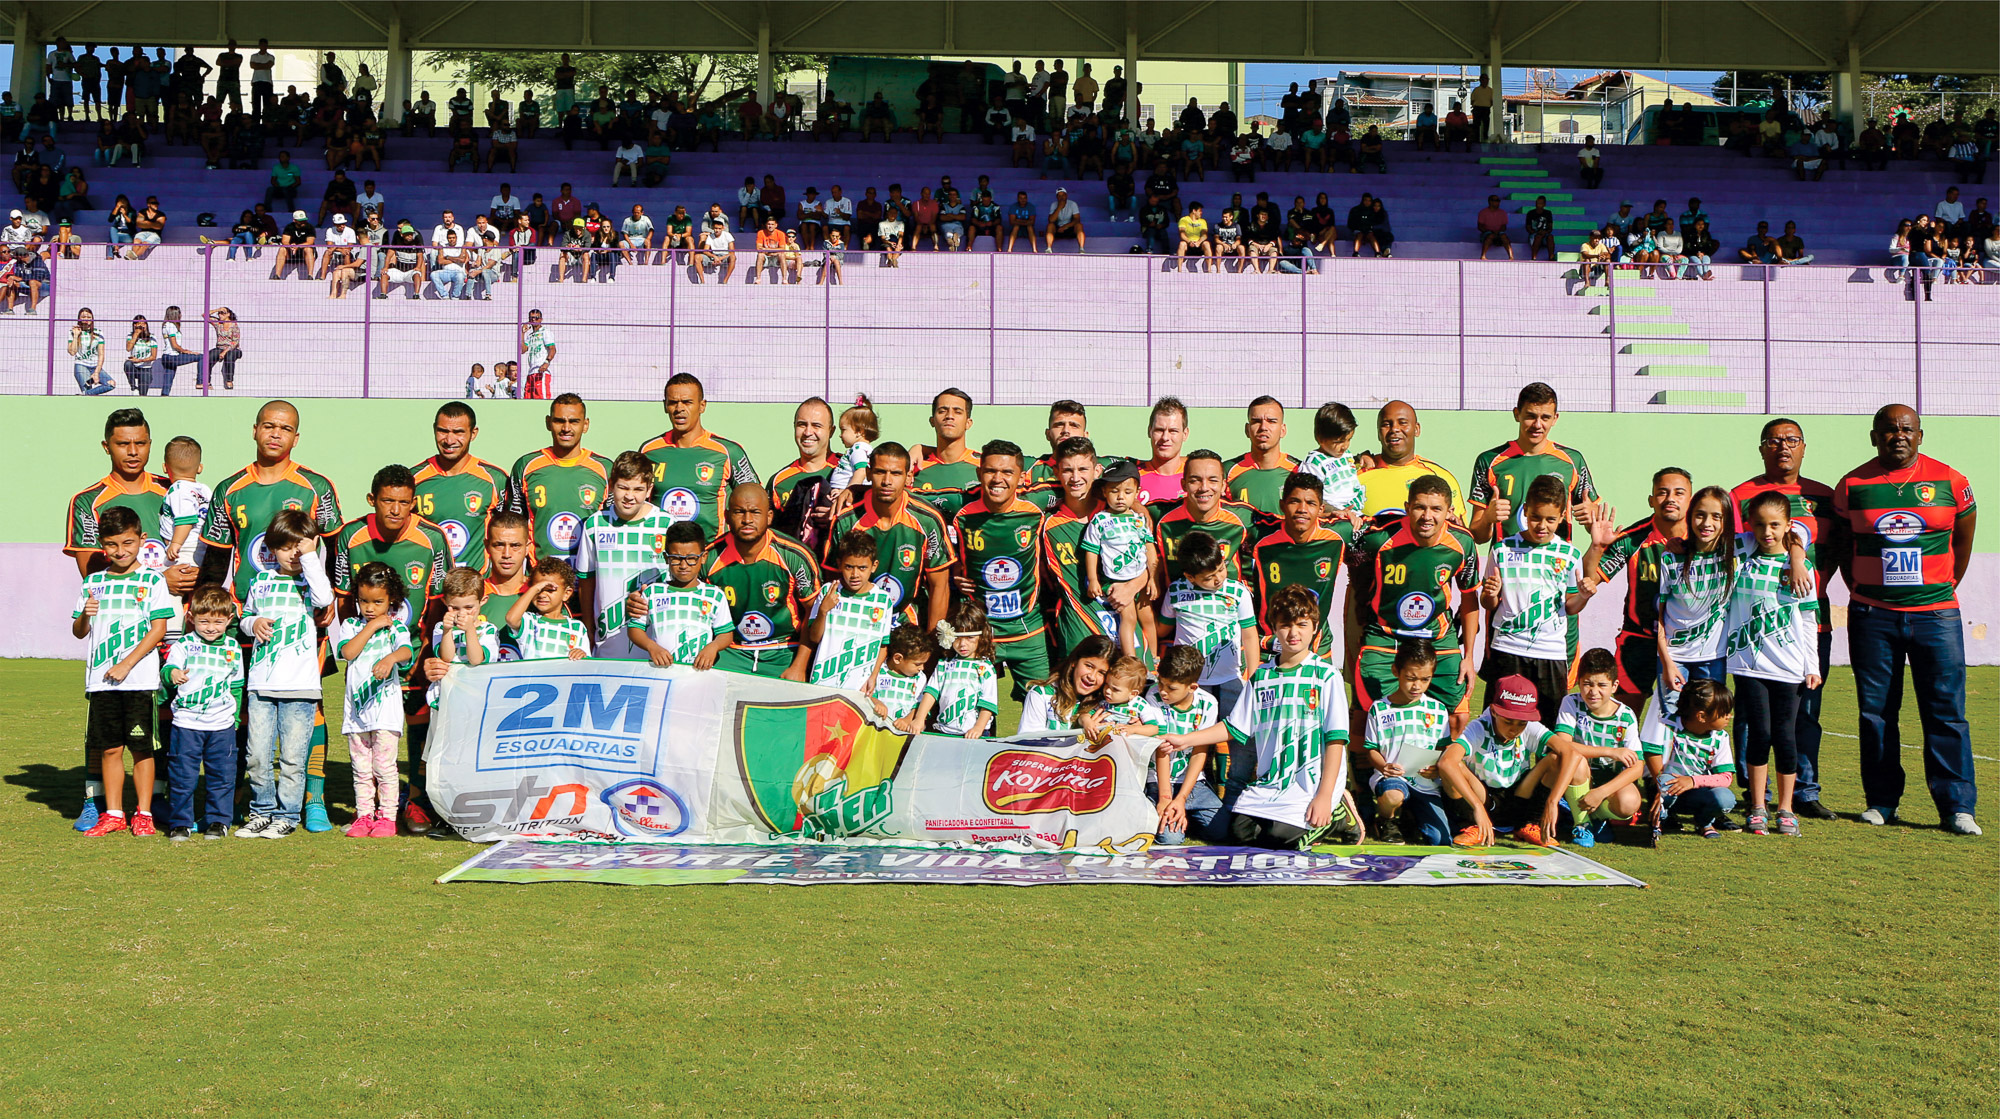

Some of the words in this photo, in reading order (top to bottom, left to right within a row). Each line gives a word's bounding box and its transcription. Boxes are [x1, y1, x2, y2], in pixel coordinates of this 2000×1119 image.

[533, 484, 547, 508] 3
[236, 504, 248, 530] 5
[667, 505, 692, 517] Bellini
[554, 530, 577, 541] Bellini
[598, 533, 616, 544] 2M
[964, 527, 986, 552] 16
[1507, 552, 1523, 562] 2M
[1885, 551, 1919, 572] 2M
[1269, 562, 1281, 584] 8
[1384, 563, 1407, 585] 20
[92, 586, 105, 596] 2M
[724, 585, 737, 607] 9
[1180, 593, 1195, 602] 2M
[655, 597, 670, 607] 2M
[988, 592, 1020, 614] 2M
[1727, 604, 1793, 658] SUPER
[189, 644, 202, 652] 2M
[811, 639, 882, 683] SUPER
[879, 678, 892, 687] 2M
[1259, 689, 1275, 702] 2M
[496, 683, 650, 734] 2M
[1380, 713, 1395, 724] 2M
[495, 738, 637, 758] ESQUADRIAS
[1011, 758, 1093, 774] SUPERMERCADO
[992, 769, 1108, 793] Koyama
[925, 818, 969, 827] PANIFICADORA
[969, 818, 974, 826] E
[974, 817, 1015, 826] CONFEITARIA
[499, 852, 804, 868] ESPORTE
[811, 853, 862, 867] E
